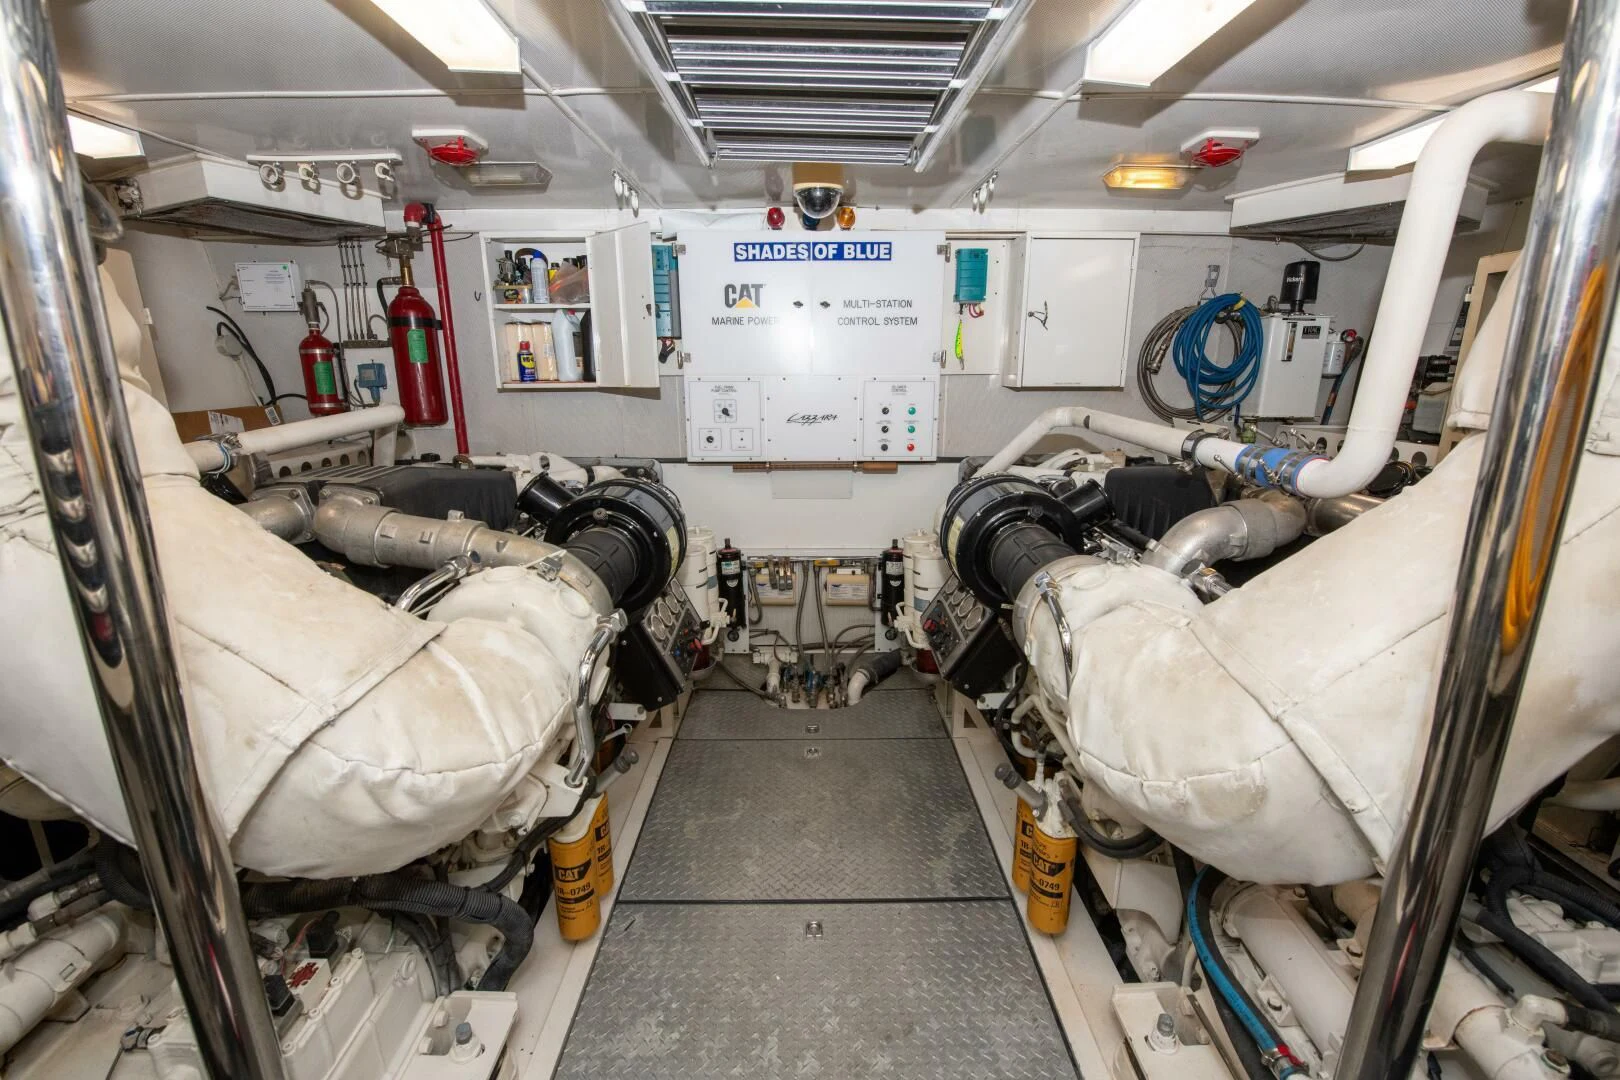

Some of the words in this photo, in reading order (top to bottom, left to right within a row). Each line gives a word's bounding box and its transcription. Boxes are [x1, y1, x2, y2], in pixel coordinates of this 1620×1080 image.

[735, 244, 809, 260] SHADES
[814, 243, 838, 259] OF
[844, 243, 891, 259] BLUE
[724, 283, 764, 308] CAT
[843, 300, 913, 308] MULTI-STATION
[711, 316, 745, 326] MARINE
[837, 316, 880, 326] CONTROL
[883, 316, 918, 326] SYSTEM
[1033, 853, 1050, 873] CAT
[558, 869, 579, 881] CAT
